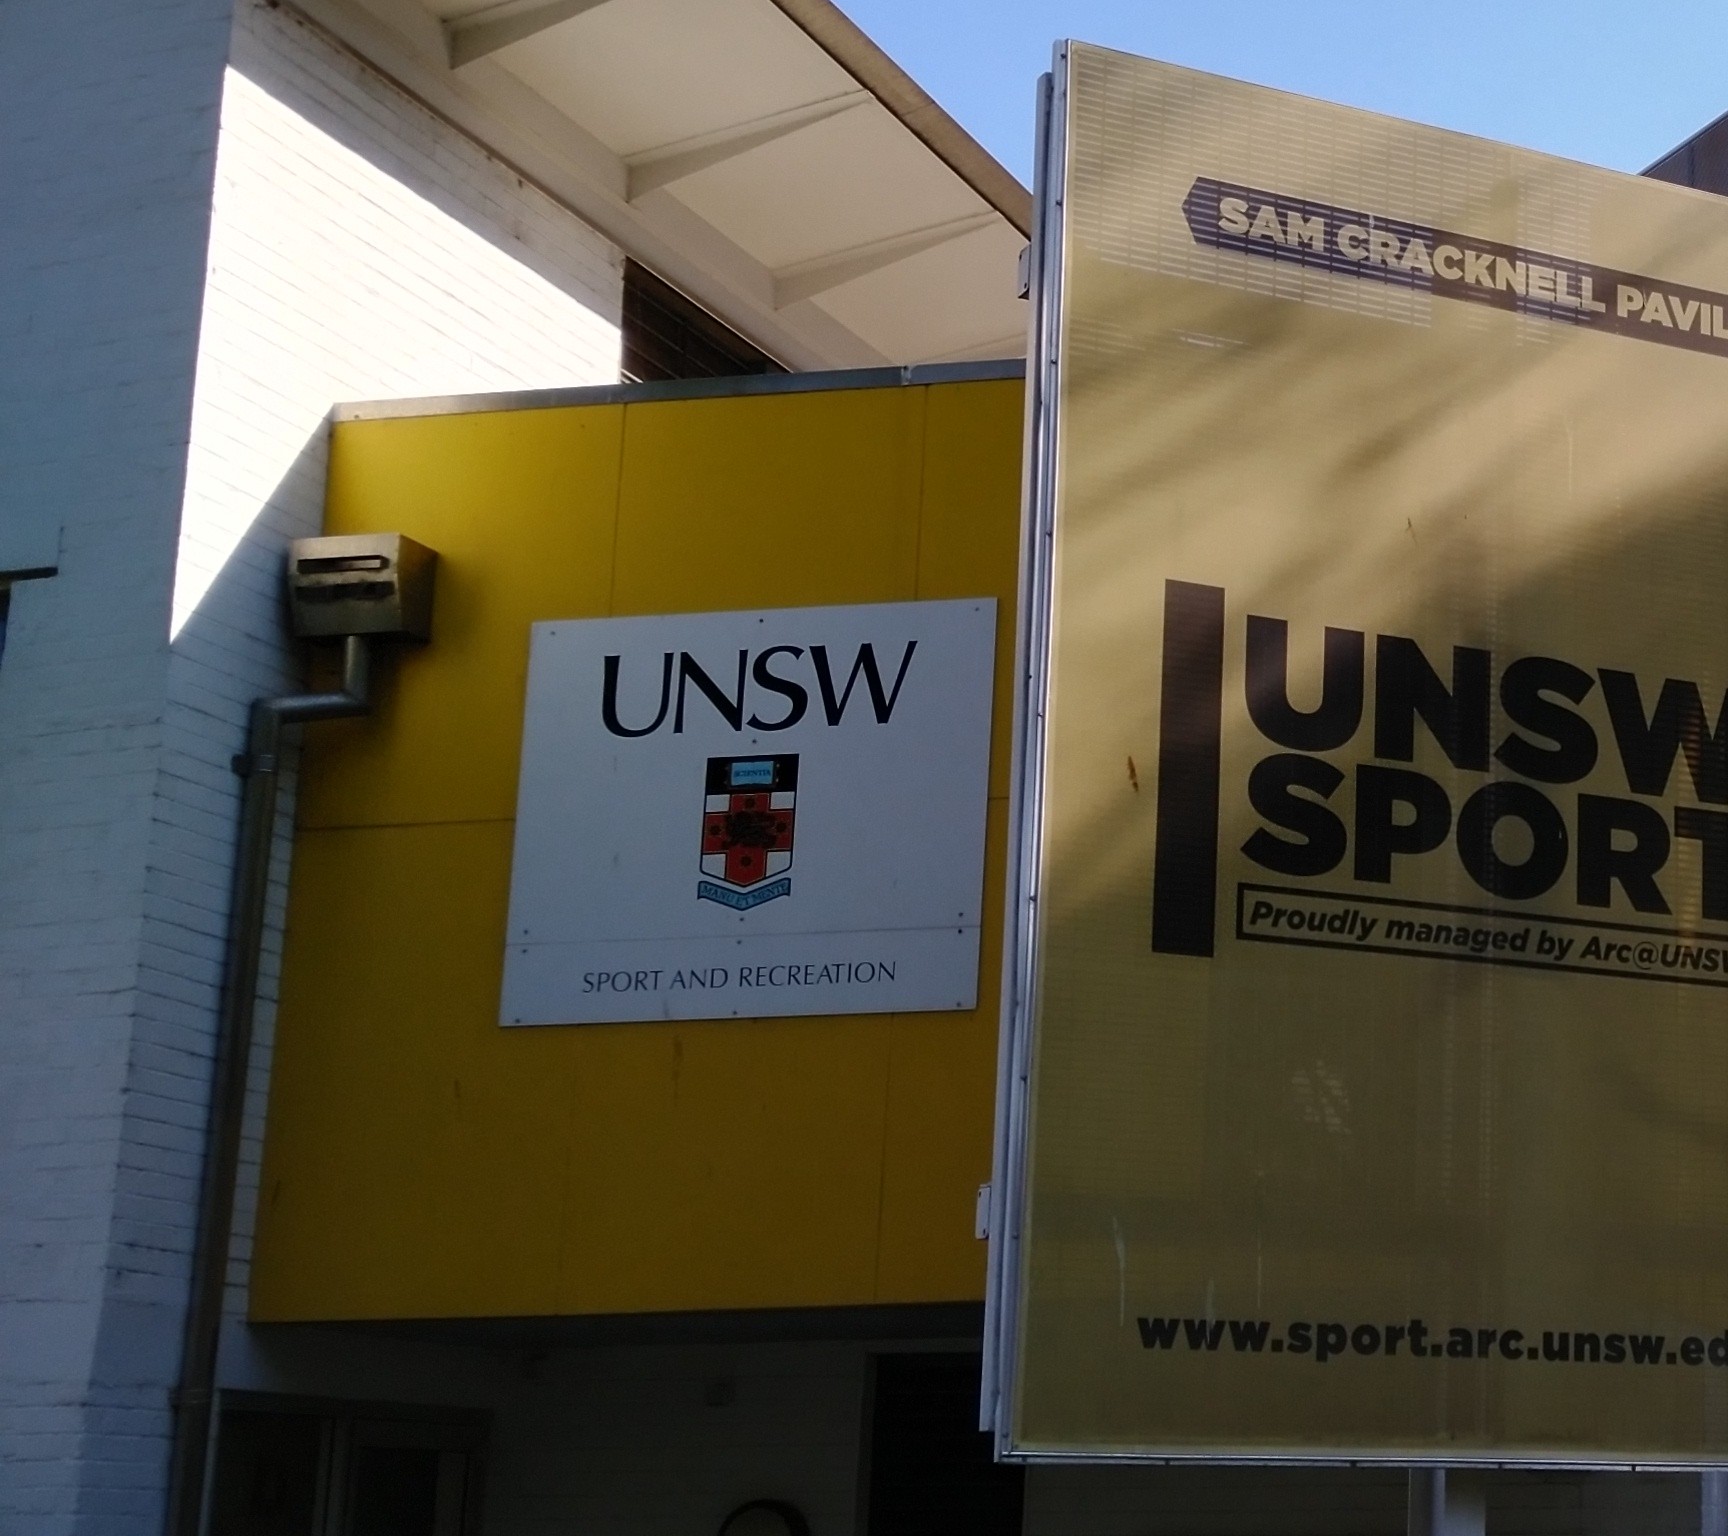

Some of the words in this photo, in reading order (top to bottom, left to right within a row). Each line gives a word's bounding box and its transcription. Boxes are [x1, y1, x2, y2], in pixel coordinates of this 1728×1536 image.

[1217, 197, 1325, 253] SAM
[1337, 224, 1605, 313] CRACKNELL
[601, 639, 918, 737] UNSW
[734, 768, 770, 778] SCIENTIA
[703, 885, 735, 903] MANU
[737, 895, 750, 906] ET
[753, 882, 786, 901] MENTE
[1249, 900, 1377, 942] Proudly
[1385, 918, 1531, 956] managed
[1535, 932, 1573, 962] by
[582, 969, 664, 994] SPORT
[670, 967, 729, 991] AND
[738, 960, 897, 988] RECREATION
